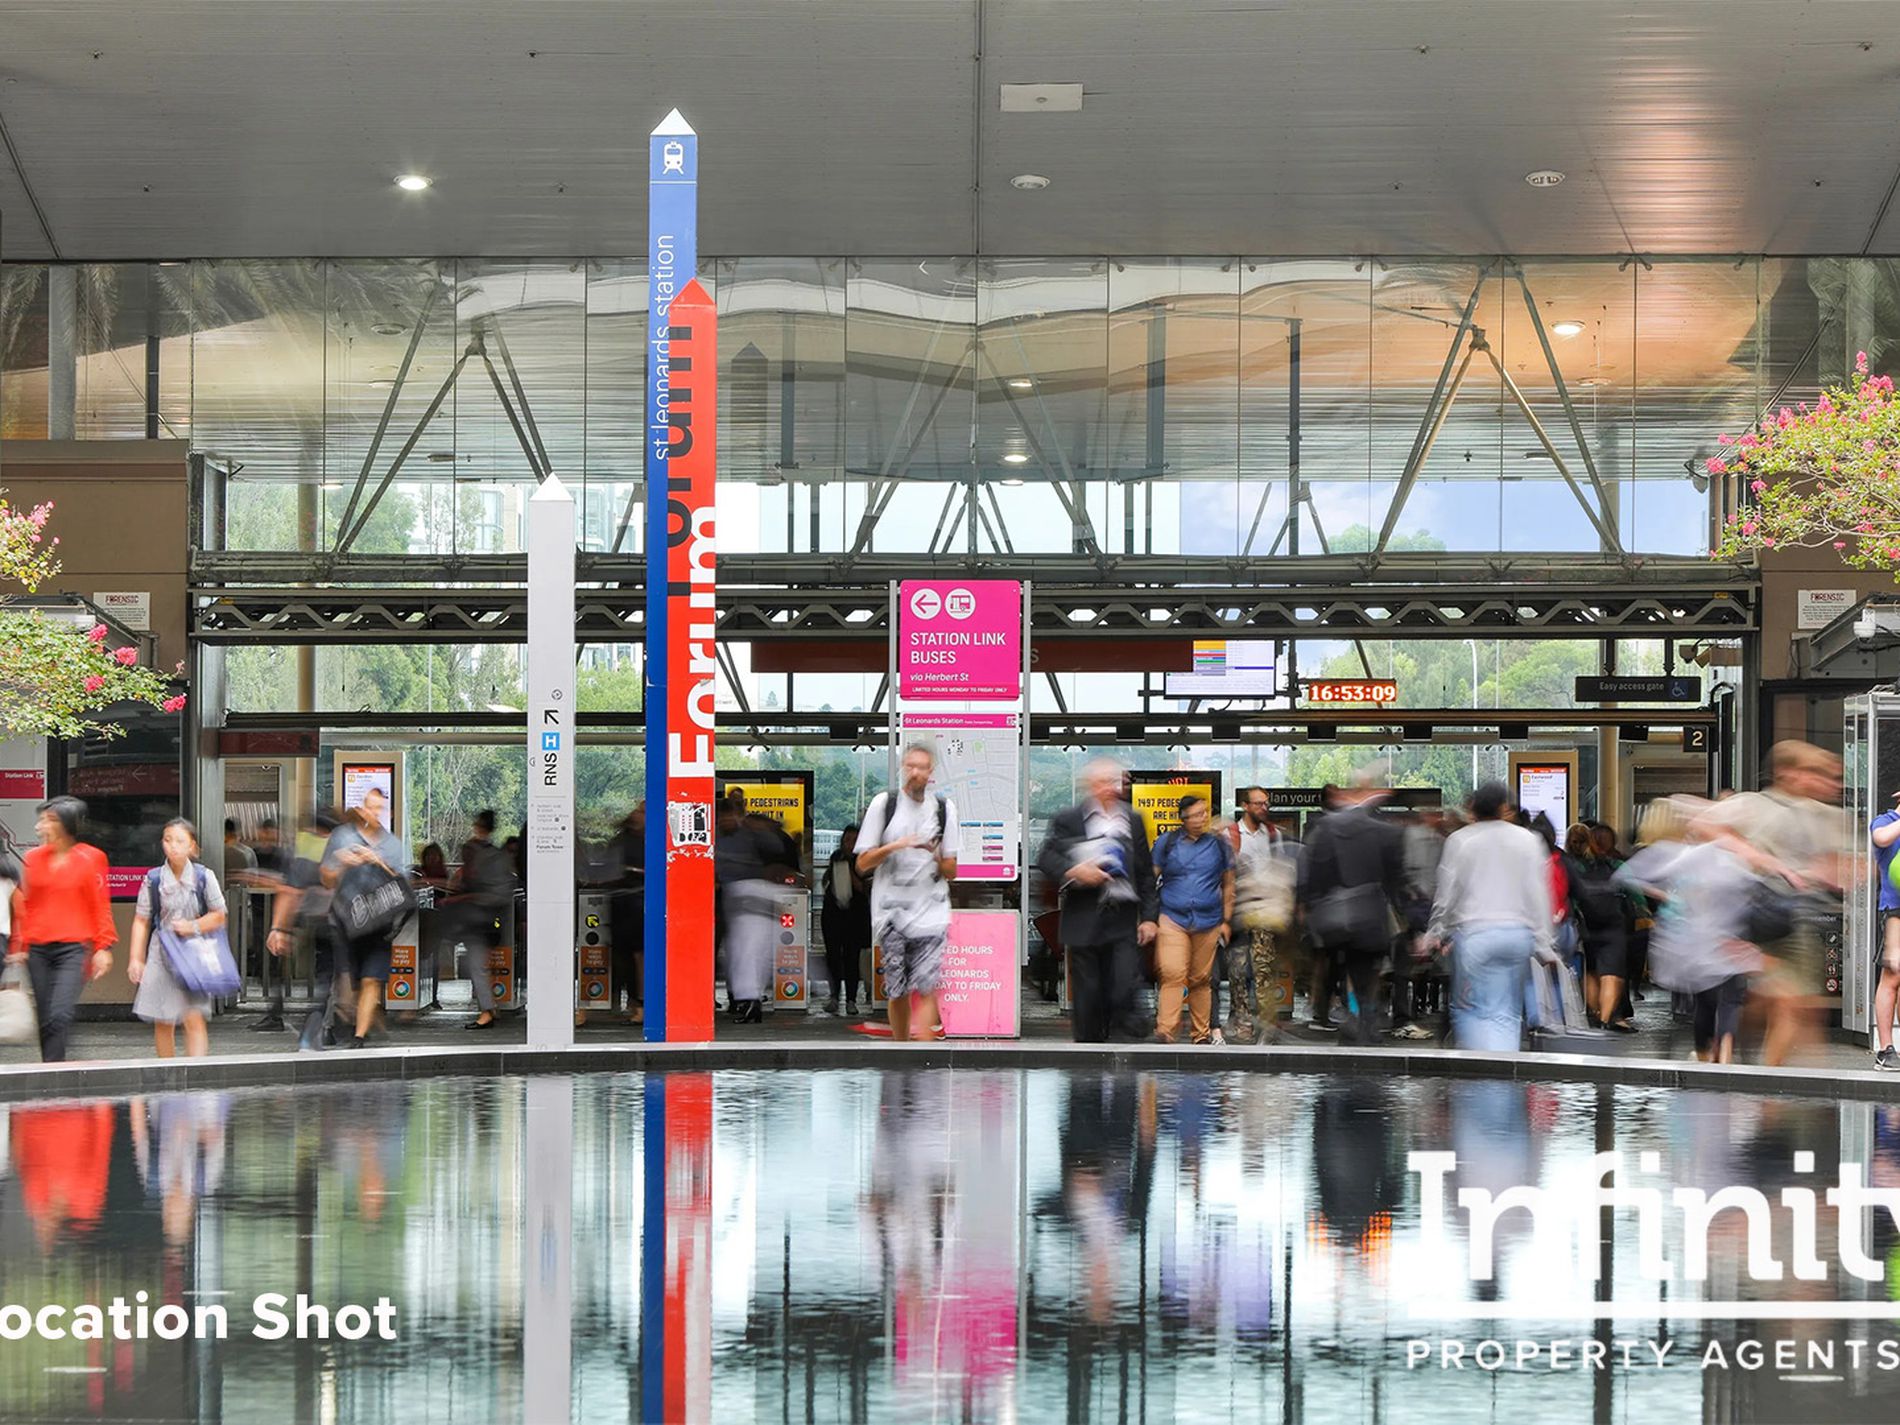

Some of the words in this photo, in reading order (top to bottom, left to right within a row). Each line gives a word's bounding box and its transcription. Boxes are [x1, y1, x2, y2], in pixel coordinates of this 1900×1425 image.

[652, 235, 674, 317] station
[651, 326, 669, 430] leonards
[653, 438, 669, 460] st
[911, 632, 970, 646] STATION
[973, 632, 1006, 646] LINK
[911, 651, 957, 664] BUSES
[910, 673, 923, 682] via
[924, 673, 958, 682] Herbert
[959, 673, 969, 682] St
[1311, 685, 1396, 701] 16:53:09
[1600, 682, 1617, 691] Easy
[1646, 683, 1665, 692] gate
[1692, 731, 1703, 746] 2
[544, 752, 557, 786] RNS
[1138, 798, 1155, 808] 1497
[1269, 792, 1288, 804] lan
[1291, 793, 1316, 804] your
[1153, 811, 1167, 821] ARE
[961, 945, 993, 955] HOURS
[948, 958, 967, 966] FOR
[955, 982, 967, 990] TO
[969, 982, 1002, 991] FRIDAY
